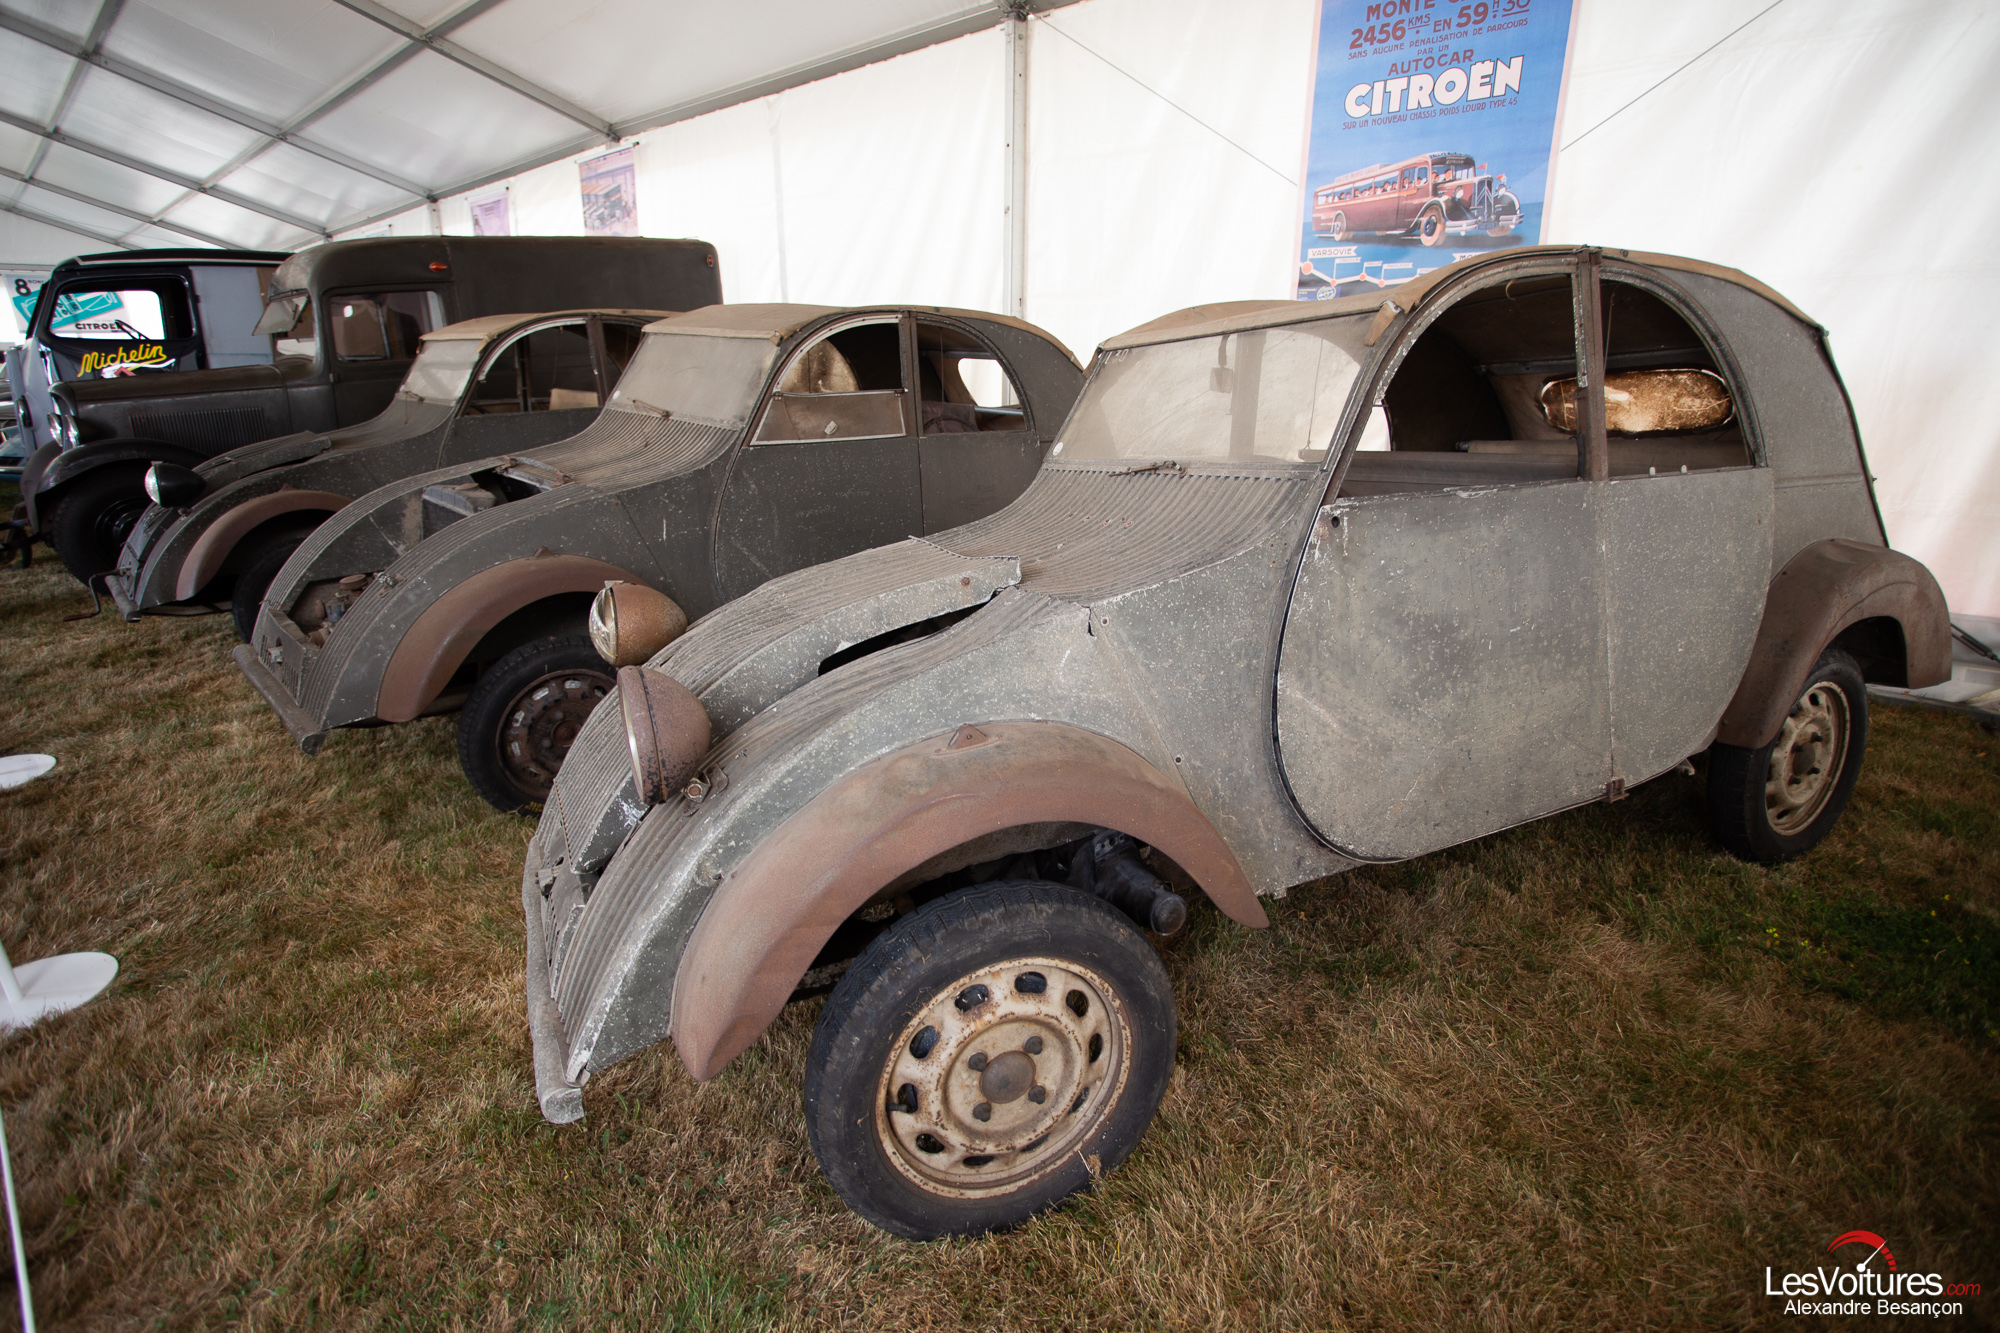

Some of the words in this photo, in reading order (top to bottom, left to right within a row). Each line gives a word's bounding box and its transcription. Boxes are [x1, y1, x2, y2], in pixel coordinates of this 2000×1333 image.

[1348, 50, 1368, 60] SANS
[1372, 43, 1404, 55] AUCUNE
[1472, 27, 1483, 36] DE
[1486, 18, 1528, 33] PARCOURS
[1349, 19, 1406, 49] 2456
[1407, 13, 1431, 27] KMS
[1433, 18, 1452, 33] EN
[1388, 49, 1474, 76] AUTOCAR
[1417, 47, 1433, 56] PAR
[1438, 44, 1449, 52] UN
[1344, 55, 1524, 118] CITROËN
[1342, 121, 1357, 130] SUR
[1358, 119, 1369, 128] UN
[1371, 113, 1407, 126] NOUVEAU
[1409, 109, 1437, 120] CHASSIS
[1439, 105, 1460, 117] POIDS
[1462, 102, 1486, 113] LOURD
[1489, 98, 1507, 109] TYPE
[1508, 96, 1518, 106] 45
[1311, 248, 1352, 257] VARSOVIE
[14, 278, 31, 297] 8
[77, 343, 167, 377] Michelin
